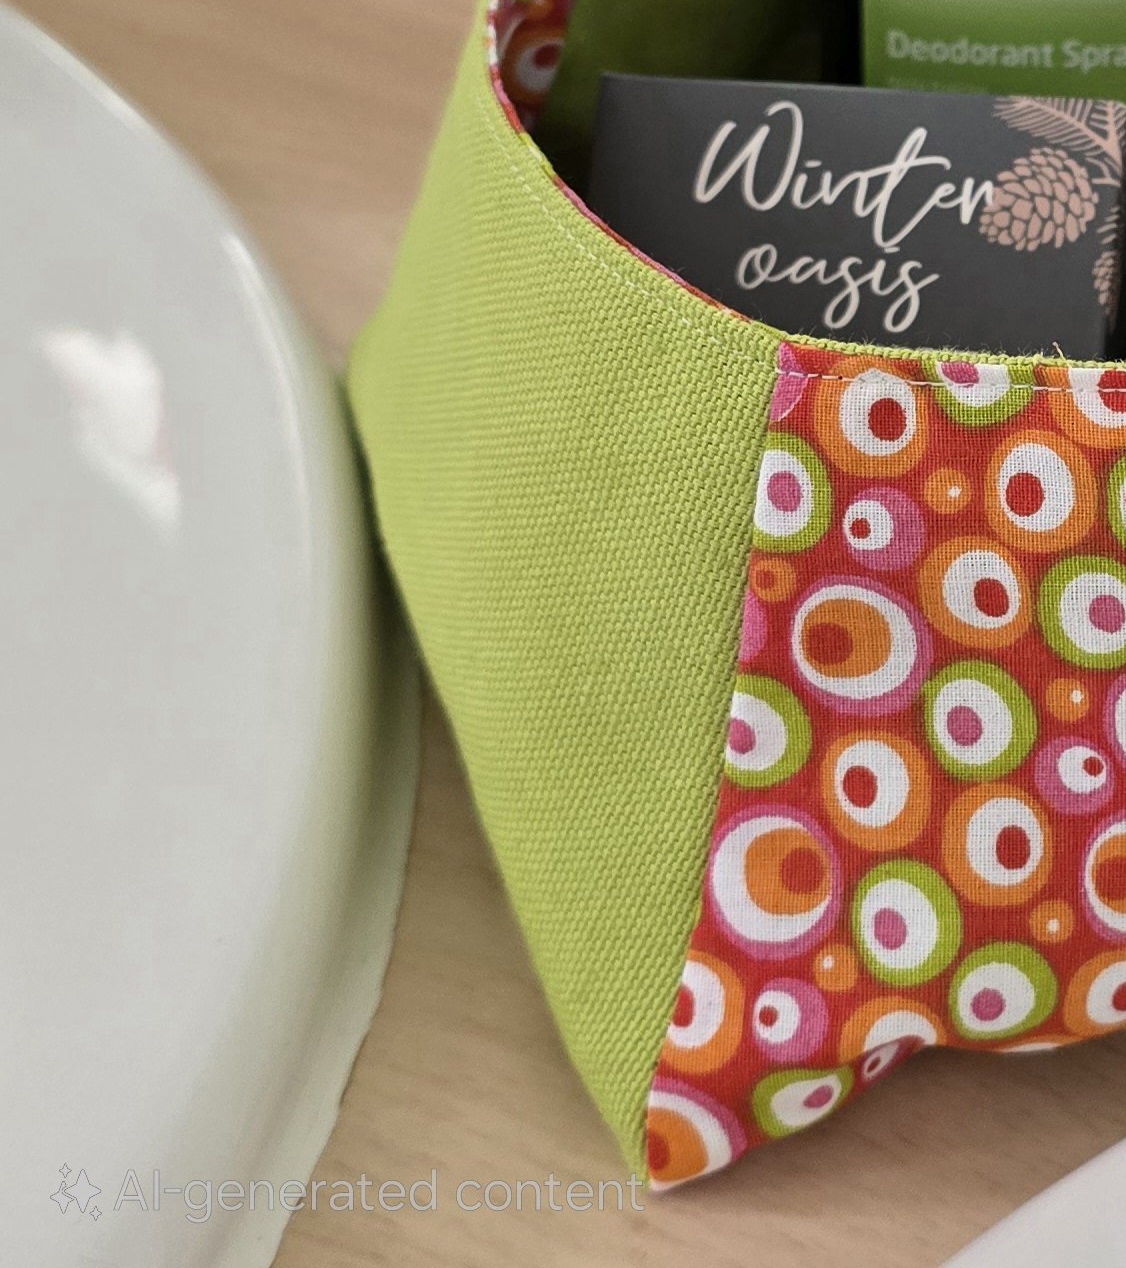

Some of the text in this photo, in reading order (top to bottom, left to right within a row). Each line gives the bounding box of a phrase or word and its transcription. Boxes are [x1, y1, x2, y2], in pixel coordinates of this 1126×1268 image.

[887, 29, 1056, 68] Deodorant
[693, 100, 996, 248] Winter
[736, 242, 940, 332] oasis
